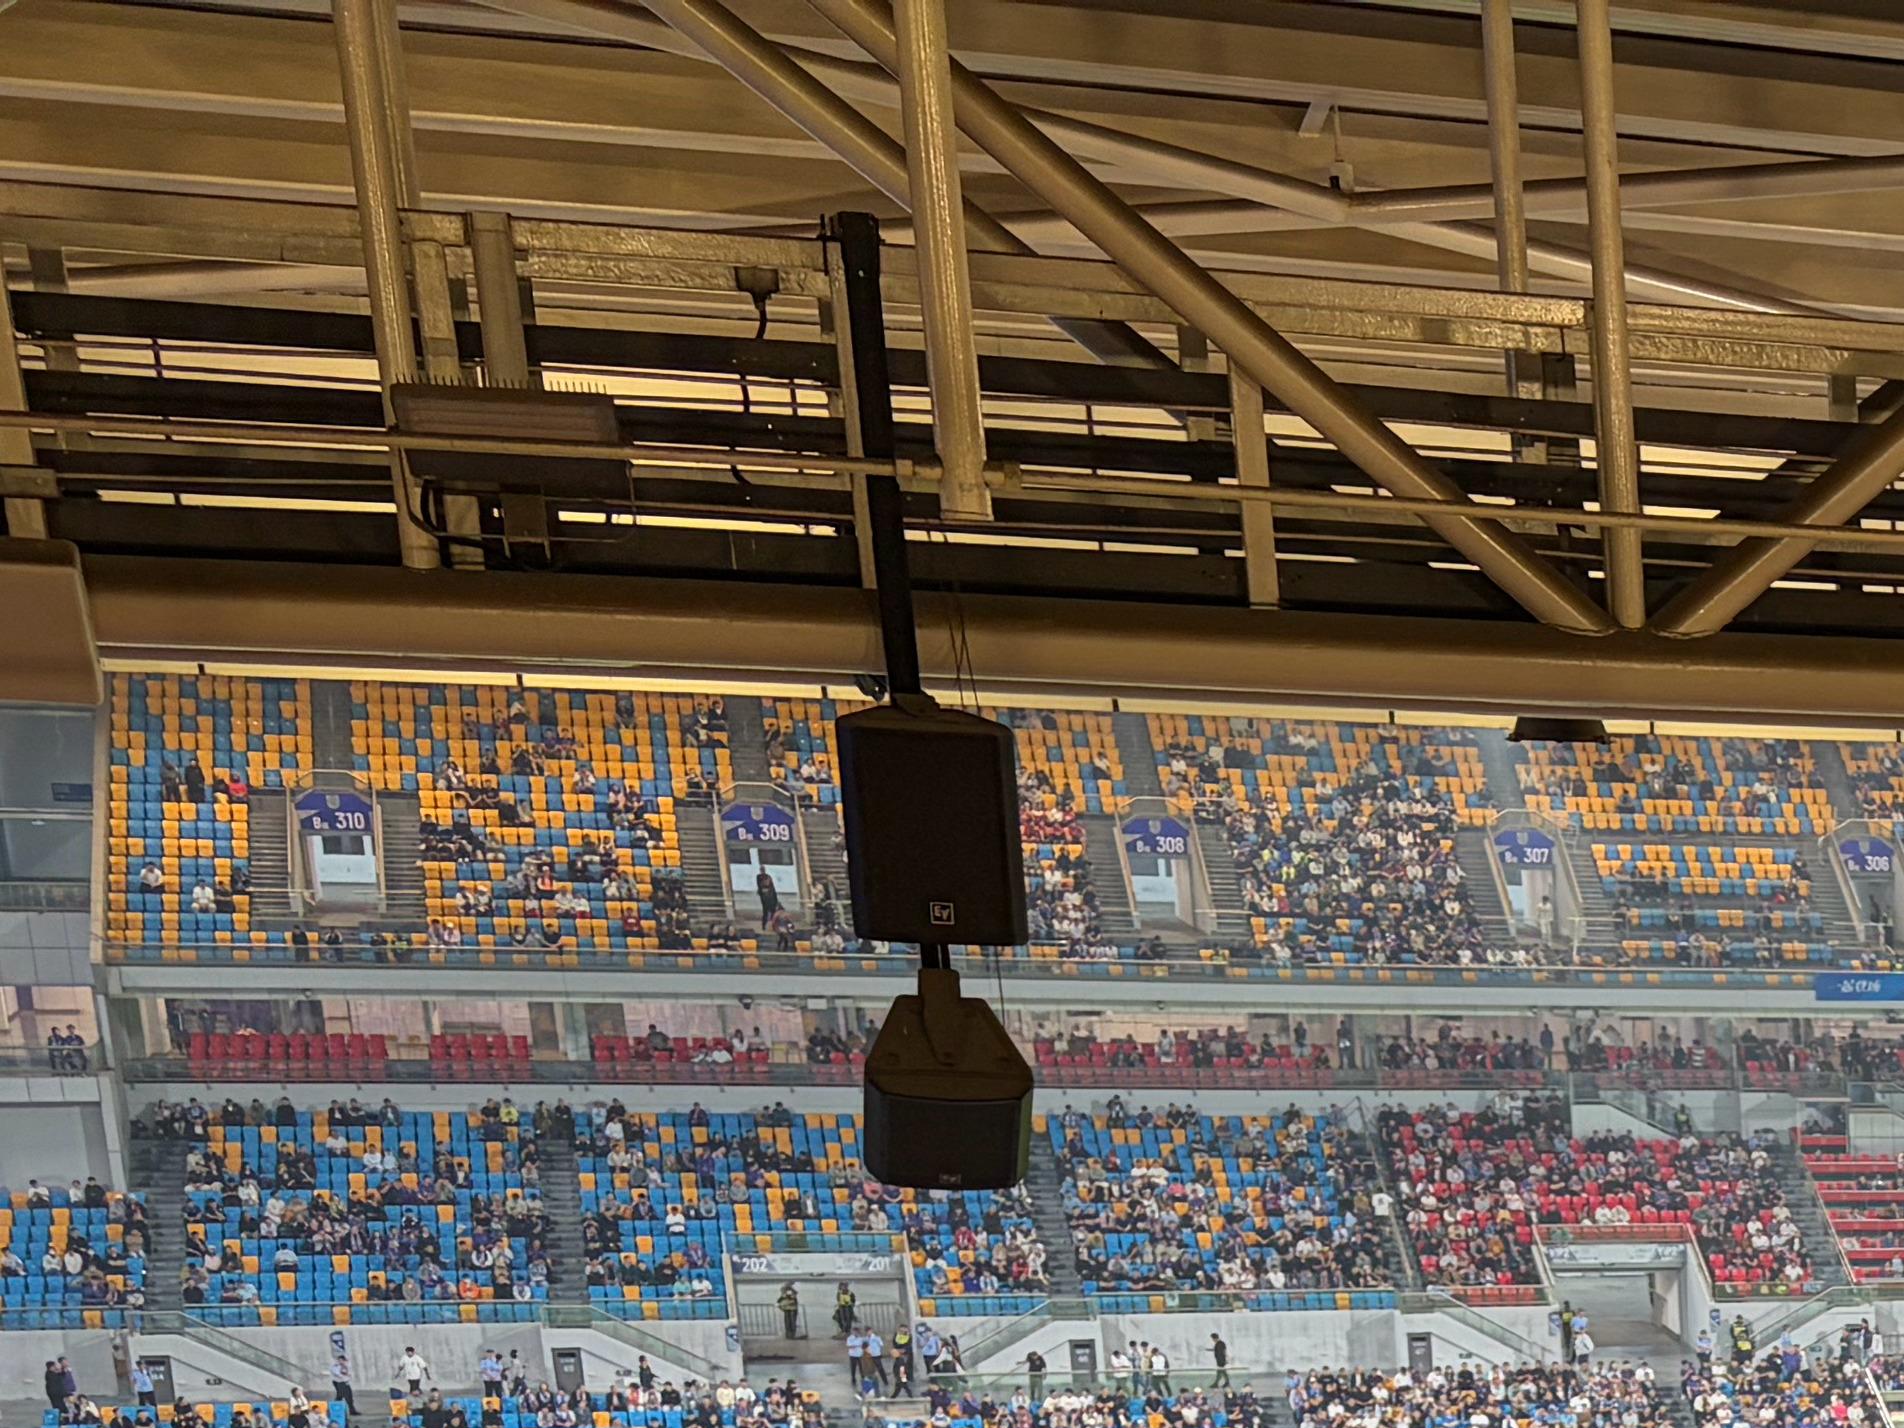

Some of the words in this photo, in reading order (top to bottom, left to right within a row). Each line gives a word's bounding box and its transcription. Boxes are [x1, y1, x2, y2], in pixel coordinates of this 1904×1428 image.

[335, 812, 365, 830] 310
[759, 823, 790, 841] 309
[1156, 836, 1185, 853] 308
[1524, 847, 1549, 863] 307
[1864, 855, 1890, 871] 306
[742, 1257, 769, 1273] 202
[868, 1256, 893, 1272] 201
